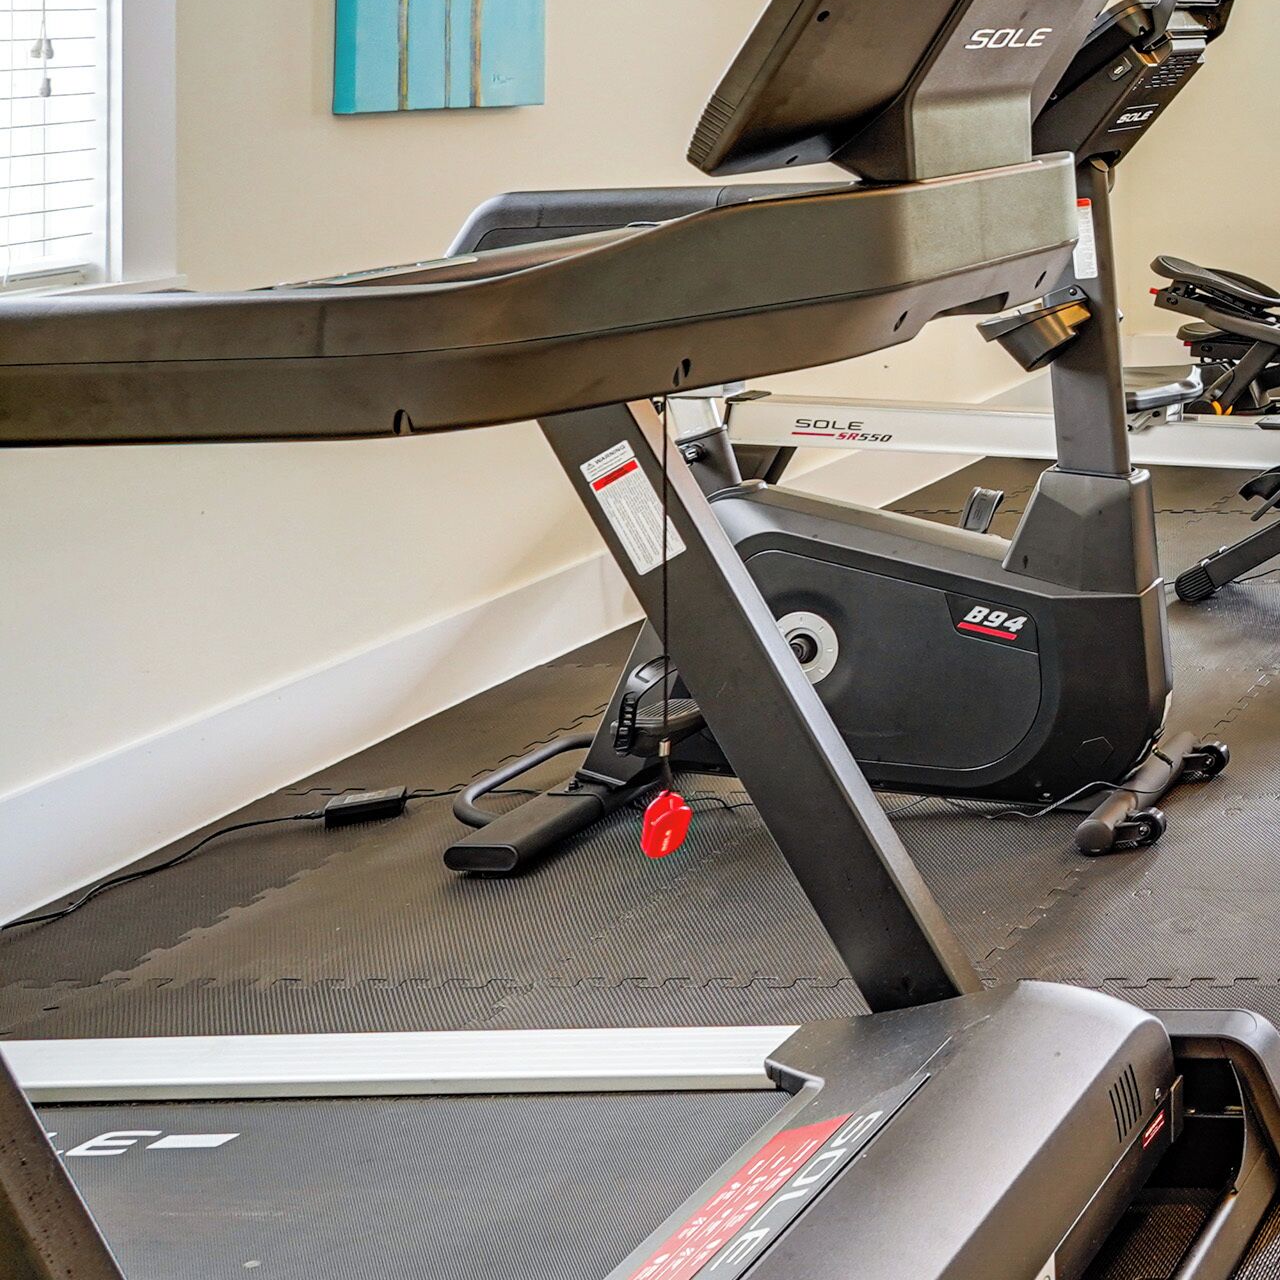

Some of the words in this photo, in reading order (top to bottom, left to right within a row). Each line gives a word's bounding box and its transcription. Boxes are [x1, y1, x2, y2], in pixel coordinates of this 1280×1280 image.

[964, 27, 1053, 50] SOLE
[1116, 110, 1154, 124] SOLE
[795, 418, 864, 431] SOLE
[836, 431, 893, 443] SR550
[963, 605, 1028, 633] B94
[709, 1110, 884, 1271] SOLE
